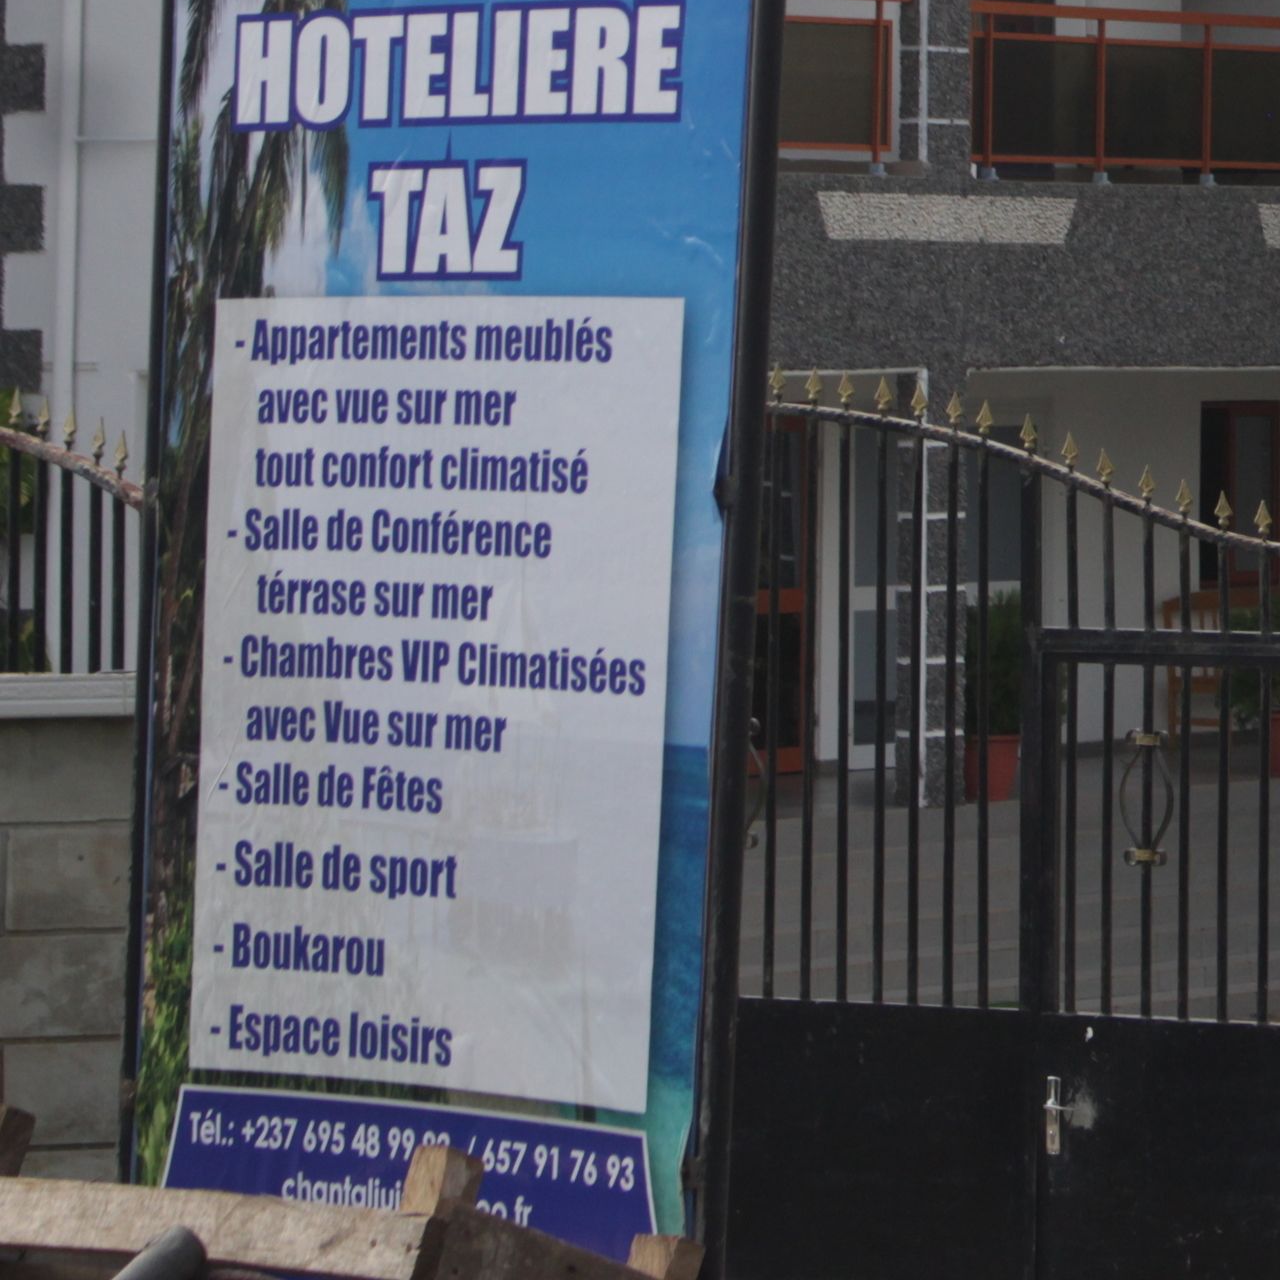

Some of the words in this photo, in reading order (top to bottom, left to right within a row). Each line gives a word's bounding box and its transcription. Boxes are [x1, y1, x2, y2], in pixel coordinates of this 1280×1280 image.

[368, 159, 527, 280] TAZ
[251, 318, 467, 365] Appartements
[474, 317, 613, 363] meublés
[257, 388, 328, 424] avec
[336, 389, 389, 424] vue
[396, 388, 447, 425] sur
[454, 389, 516, 426] mer
[256, 447, 314, 488] tout
[321, 445, 433, 489] confort
[440, 447, 589, 494] climatisé
[244, 508, 318, 552] Salle
[326, 508, 363, 553] de
[371, 509, 552, 558] Conférence
[256, 570, 366, 616] térrase
[374, 580, 425, 618] sur
[431, 581, 494, 621] mer
[240, 634, 393, 682] Chambres
[401, 639, 451, 684] VIP
[458, 641, 646, 697] Climatisées
[246, 705, 316, 742] avec
[324, 700, 379, 746] Vue
[387, 708, 438, 748] sur
[444, 712, 508, 753] mer
[236, 761, 310, 806] Salle
[317, 764, 354, 809] de
[362, 765, 443, 814] Fêtes
[234, 840, 313, 889] Salle
[322, 844, 361, 892] de
[369, 854, 457, 899] sport
[232, 923, 385, 977] Boukarou
[229, 1004, 341, 1057] Espace
[348, 1012, 453, 1067] loisirs
[190, 1108, 234, 1146] Tél.:
[241, 1115, 298, 1150] +237
[302, 1120, 346, 1155] 695
[351, 1123, 380, 1159] 48
[387, 1126, 415, 1161] 99
[482, 1138, 528, 1175] 657
[533, 1144, 560, 1181] 91
[569, 1149, 598, 1187] 76
[606, 1154, 635, 1192] 93
